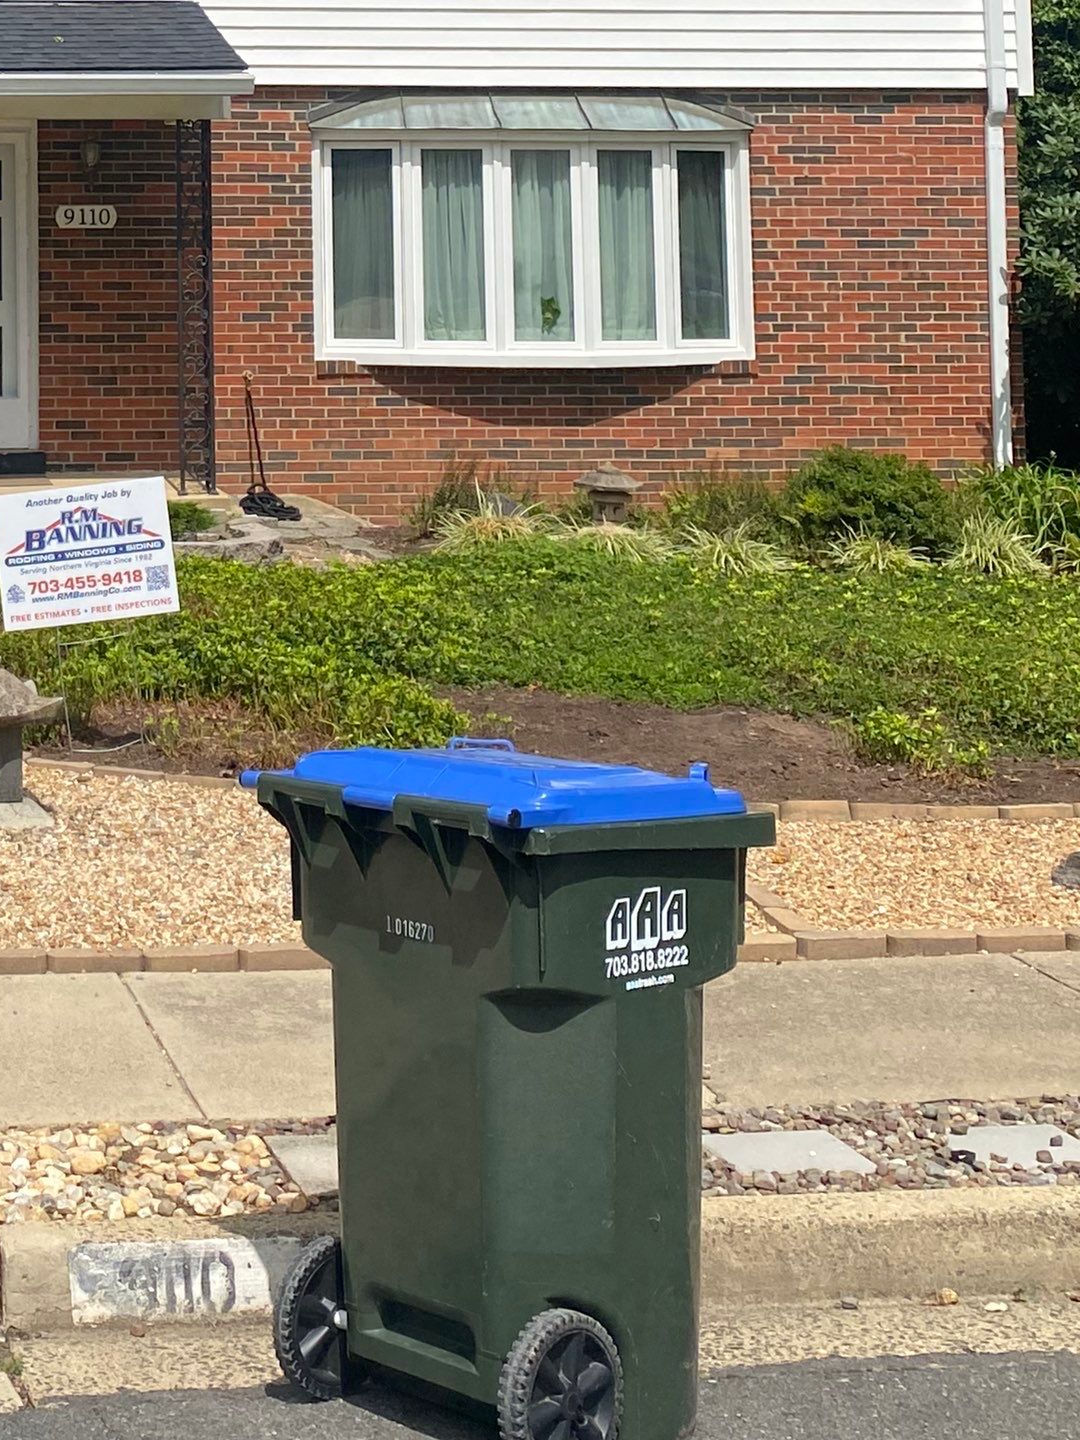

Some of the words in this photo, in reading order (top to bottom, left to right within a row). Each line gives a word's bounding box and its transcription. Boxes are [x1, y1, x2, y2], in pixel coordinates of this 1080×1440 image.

[63, 208, 111, 226] 9110
[25, 497, 63, 508] Another
[66, 492, 98, 503] Quality
[101, 490, 118, 500] Job
[120, 488, 132, 498] by
[60, 507, 102, 525] R.M.
[24, 517, 144, 553] BANNING
[8, 553, 56, 565] ROOFING
[64, 546, 117, 559] WINDOWS
[125, 540, 162, 552] SIDING
[20, 566, 47, 575] Serving
[49, 563, 82, 573] Northern
[84, 559, 112, 569] Virginia
[113, 557, 132, 565] Since
[27, 569, 144, 595] 703-455-9418
[31, 584, 142, 604] www.RMBanningCo.com
[10, 613, 32, 623] FREE
[34, 608, 81, 620] ESTIMATES
[90, 604, 113, 613] FREE
[114, 597, 173, 611] INSPECTIONS
[606, 886, 687, 952] AAA
[605, 945, 689, 978] 703.818.8222
